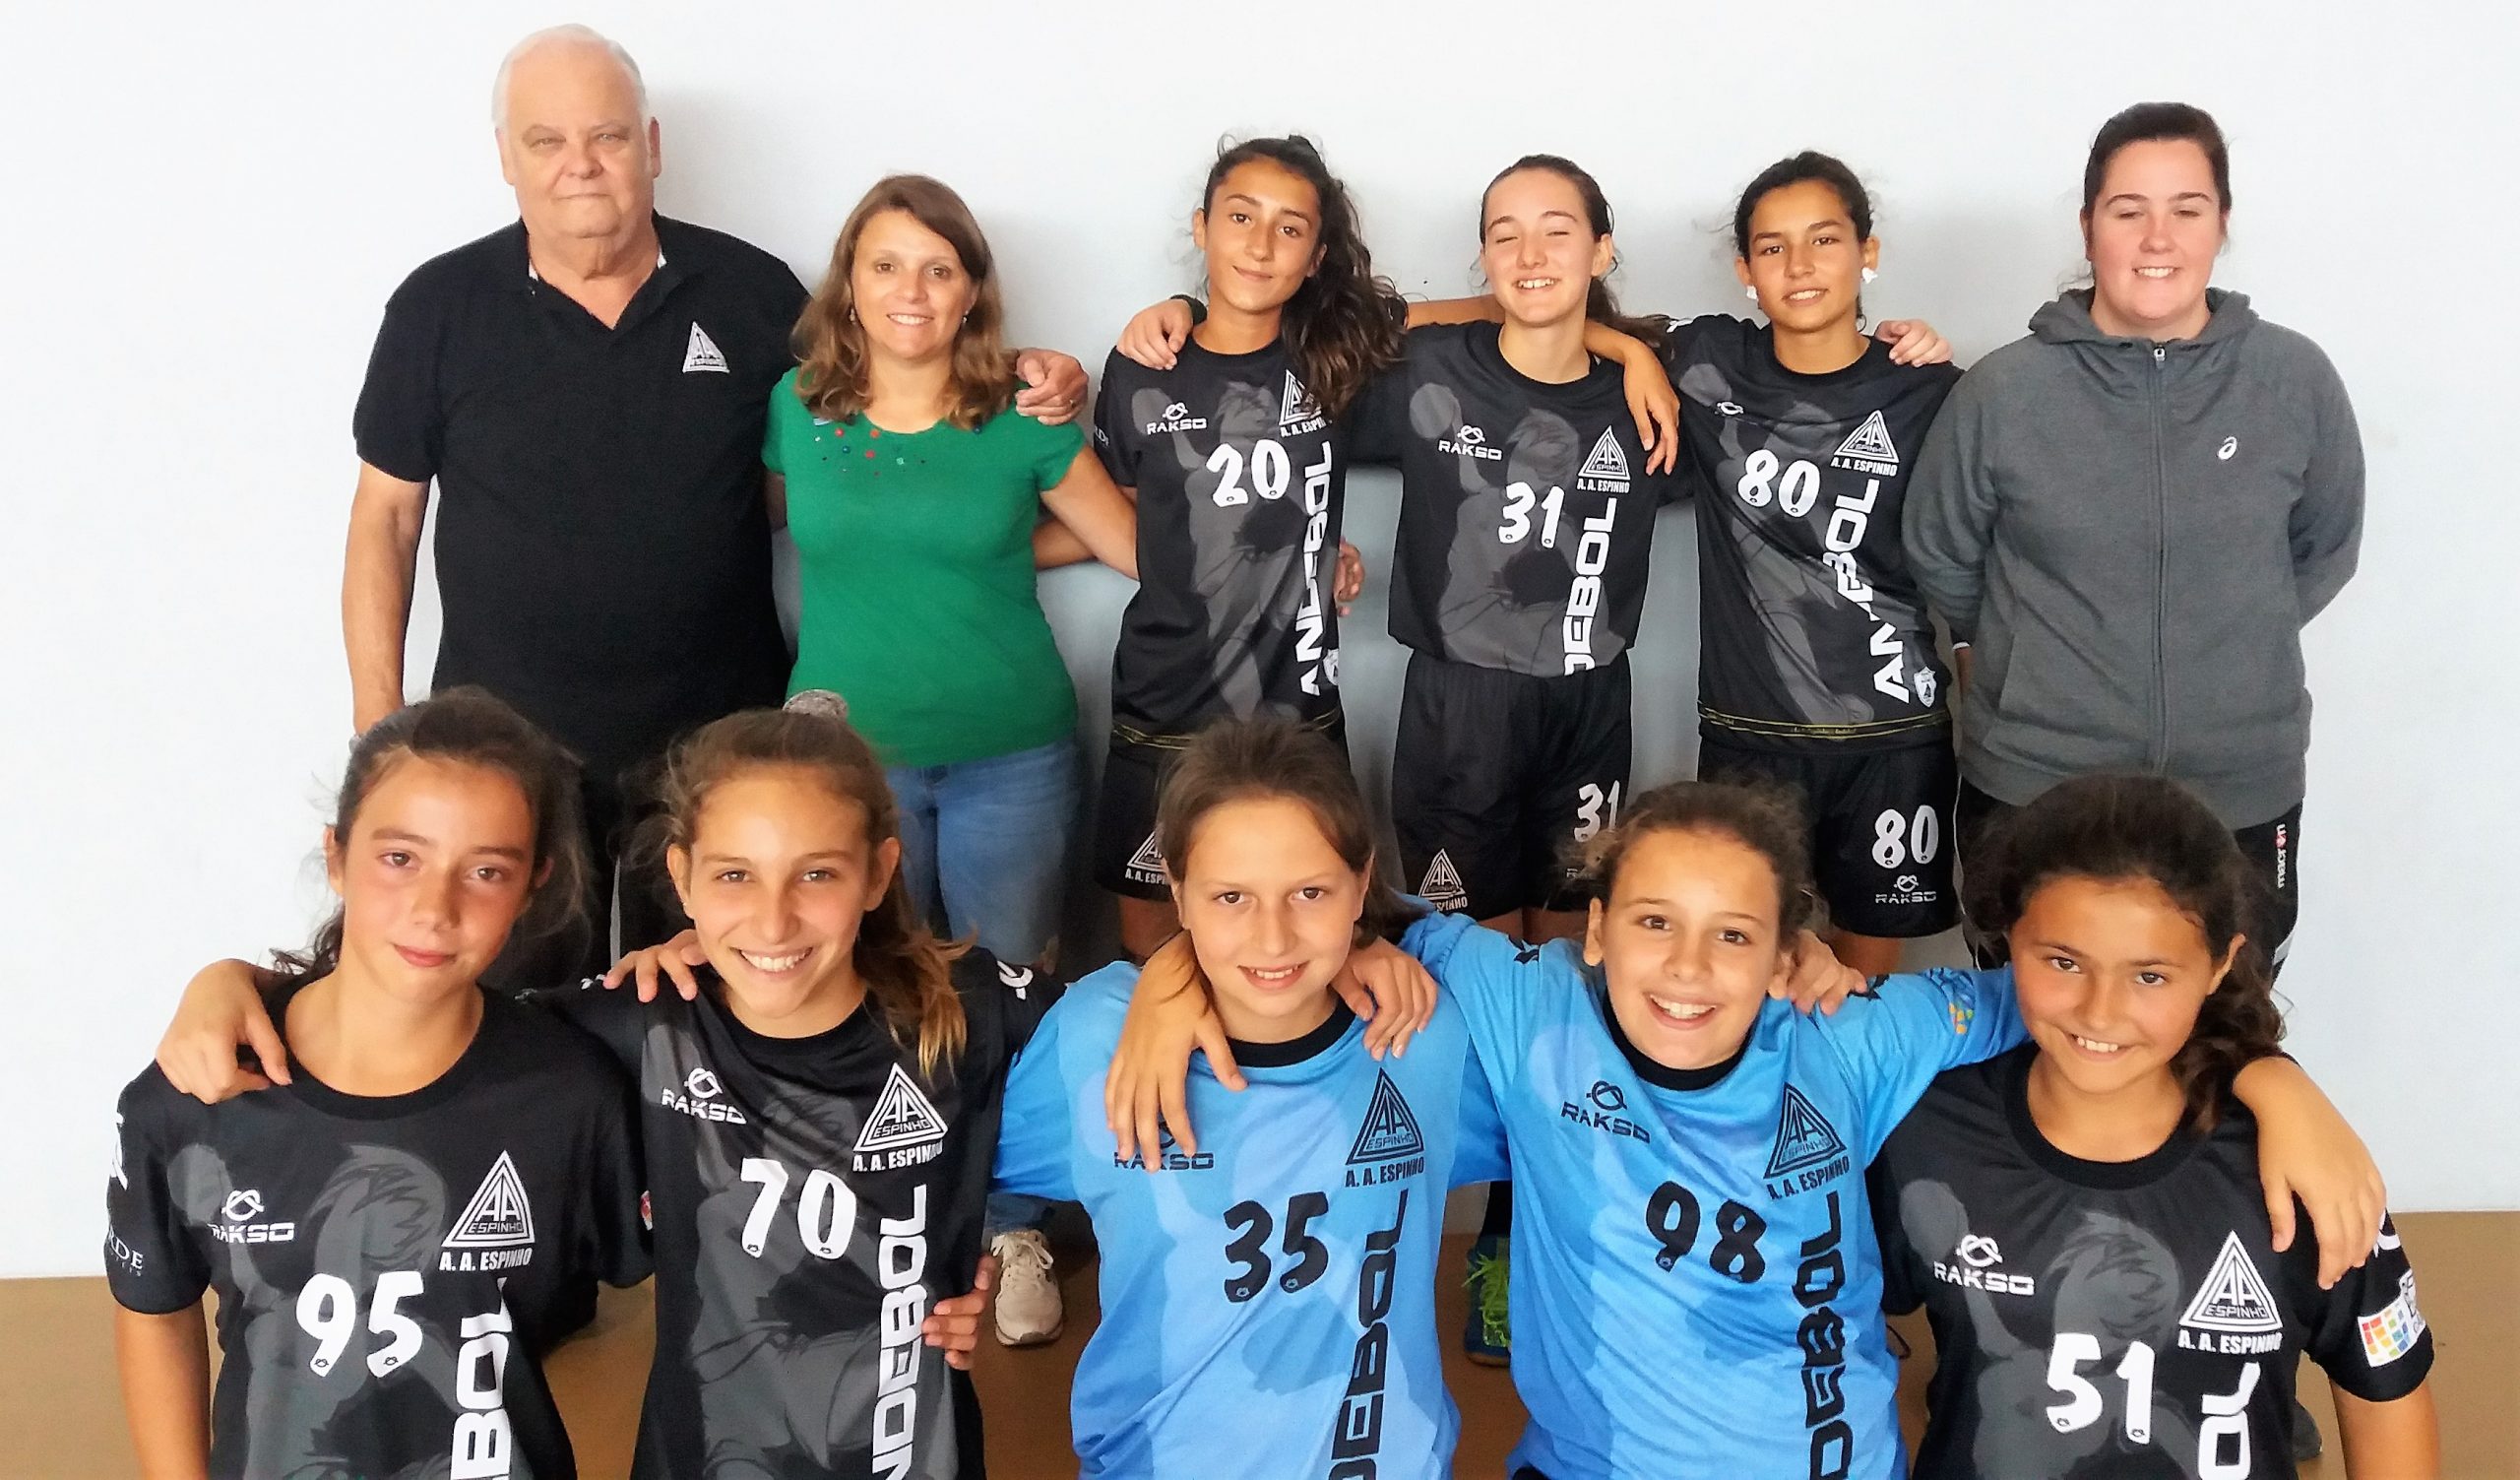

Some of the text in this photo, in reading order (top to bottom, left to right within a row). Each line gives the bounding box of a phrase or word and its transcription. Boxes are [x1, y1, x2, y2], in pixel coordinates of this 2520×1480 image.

[1146, 418, 1207, 434] RAKSO
[1438, 440, 1502, 461] RAKSO
[1830, 457, 1898, 477] A. A. ESPINHO
[1206, 439, 1291, 507] 20
[1577, 479, 1630, 493] A. A. ESPINHO
[1737, 449, 1820, 518] 80
[1498, 482, 1564, 548] 31
[1574, 780, 1620, 842] 31
[1872, 804, 1939, 869] 80
[1875, 891, 1936, 904] RAKSO
[662, 1088, 747, 1125] RAKSO
[878, 1086, 924, 1126] AA
[1371, 1093, 1410, 1137] AA
[1561, 1102, 1650, 1144] RAKSO
[872, 1119, 931, 1138] ESPINHO
[1365, 1132, 1416, 1150] ESPINHO
[852, 1154, 868, 1172] A.
[870, 1154, 886, 1172] A.
[1345, 1157, 1424, 1188] A. A. ESPINHO
[1783, 1179, 1799, 1197] A.
[1798, 1155, 1850, 1191] ESPINHO
[474, 1177, 521, 1221] AA
[740, 1157, 857, 1259] 70
[468, 1222, 523, 1233] ESPINHO
[1224, 1191, 1329, 1303] 35
[1645, 1181, 1767, 1284] 98
[439, 1248, 533, 1271] A. A. ESPINHO
[1933, 1260, 2035, 1296] RAKSO
[2211, 1258, 2263, 1307] AA
[296, 1271, 423, 1378] 95
[2205, 1305, 2269, 1318] ESPINHO
[2178, 1328, 2283, 1355] A. A. ESPINHO
[451, 1277, 512, 1480] BOL
[2047, 1333, 2155, 1445] 51
